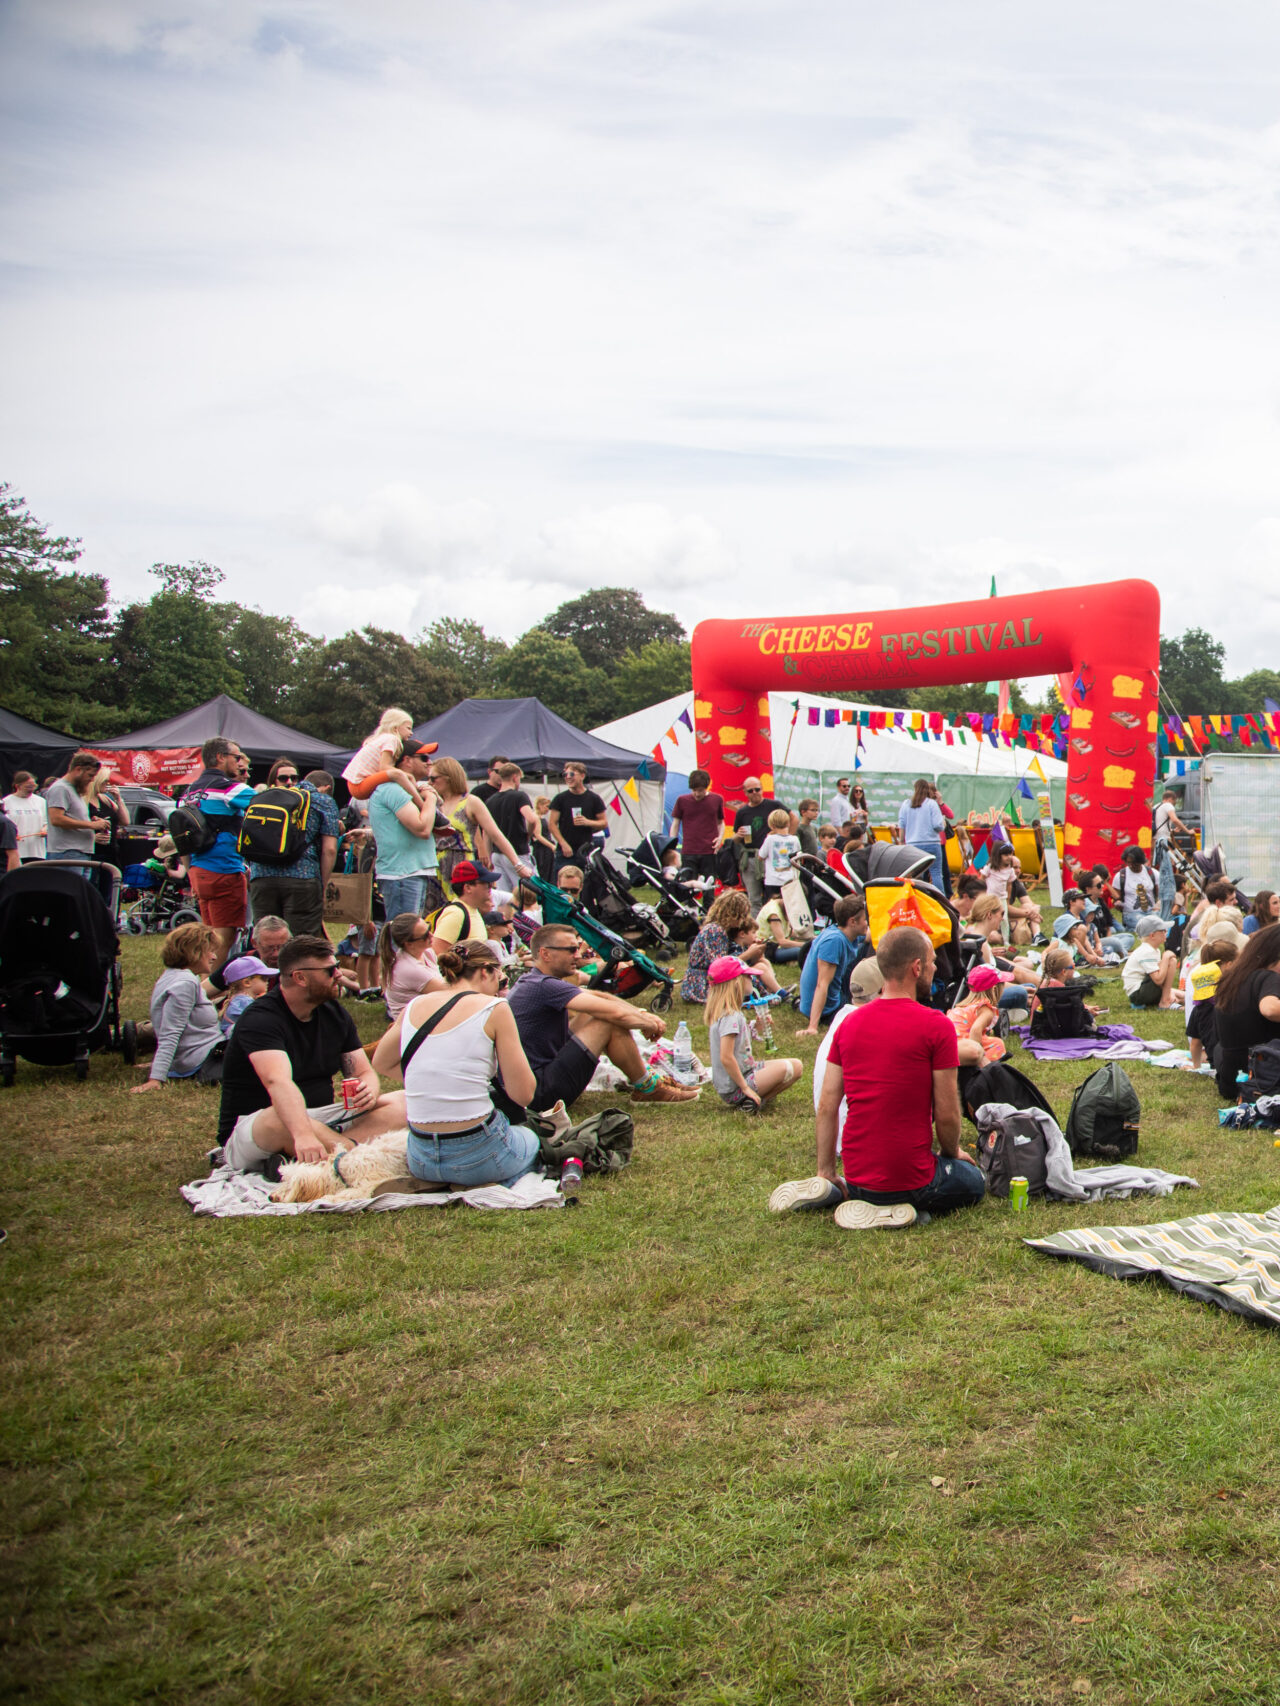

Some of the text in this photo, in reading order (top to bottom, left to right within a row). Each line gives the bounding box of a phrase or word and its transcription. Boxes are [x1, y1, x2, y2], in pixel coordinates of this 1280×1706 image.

[759, 622, 873, 655] CHEESE
[880, 617, 1043, 661] FESTIVAL
[783, 650, 919, 682] & CHILLI
